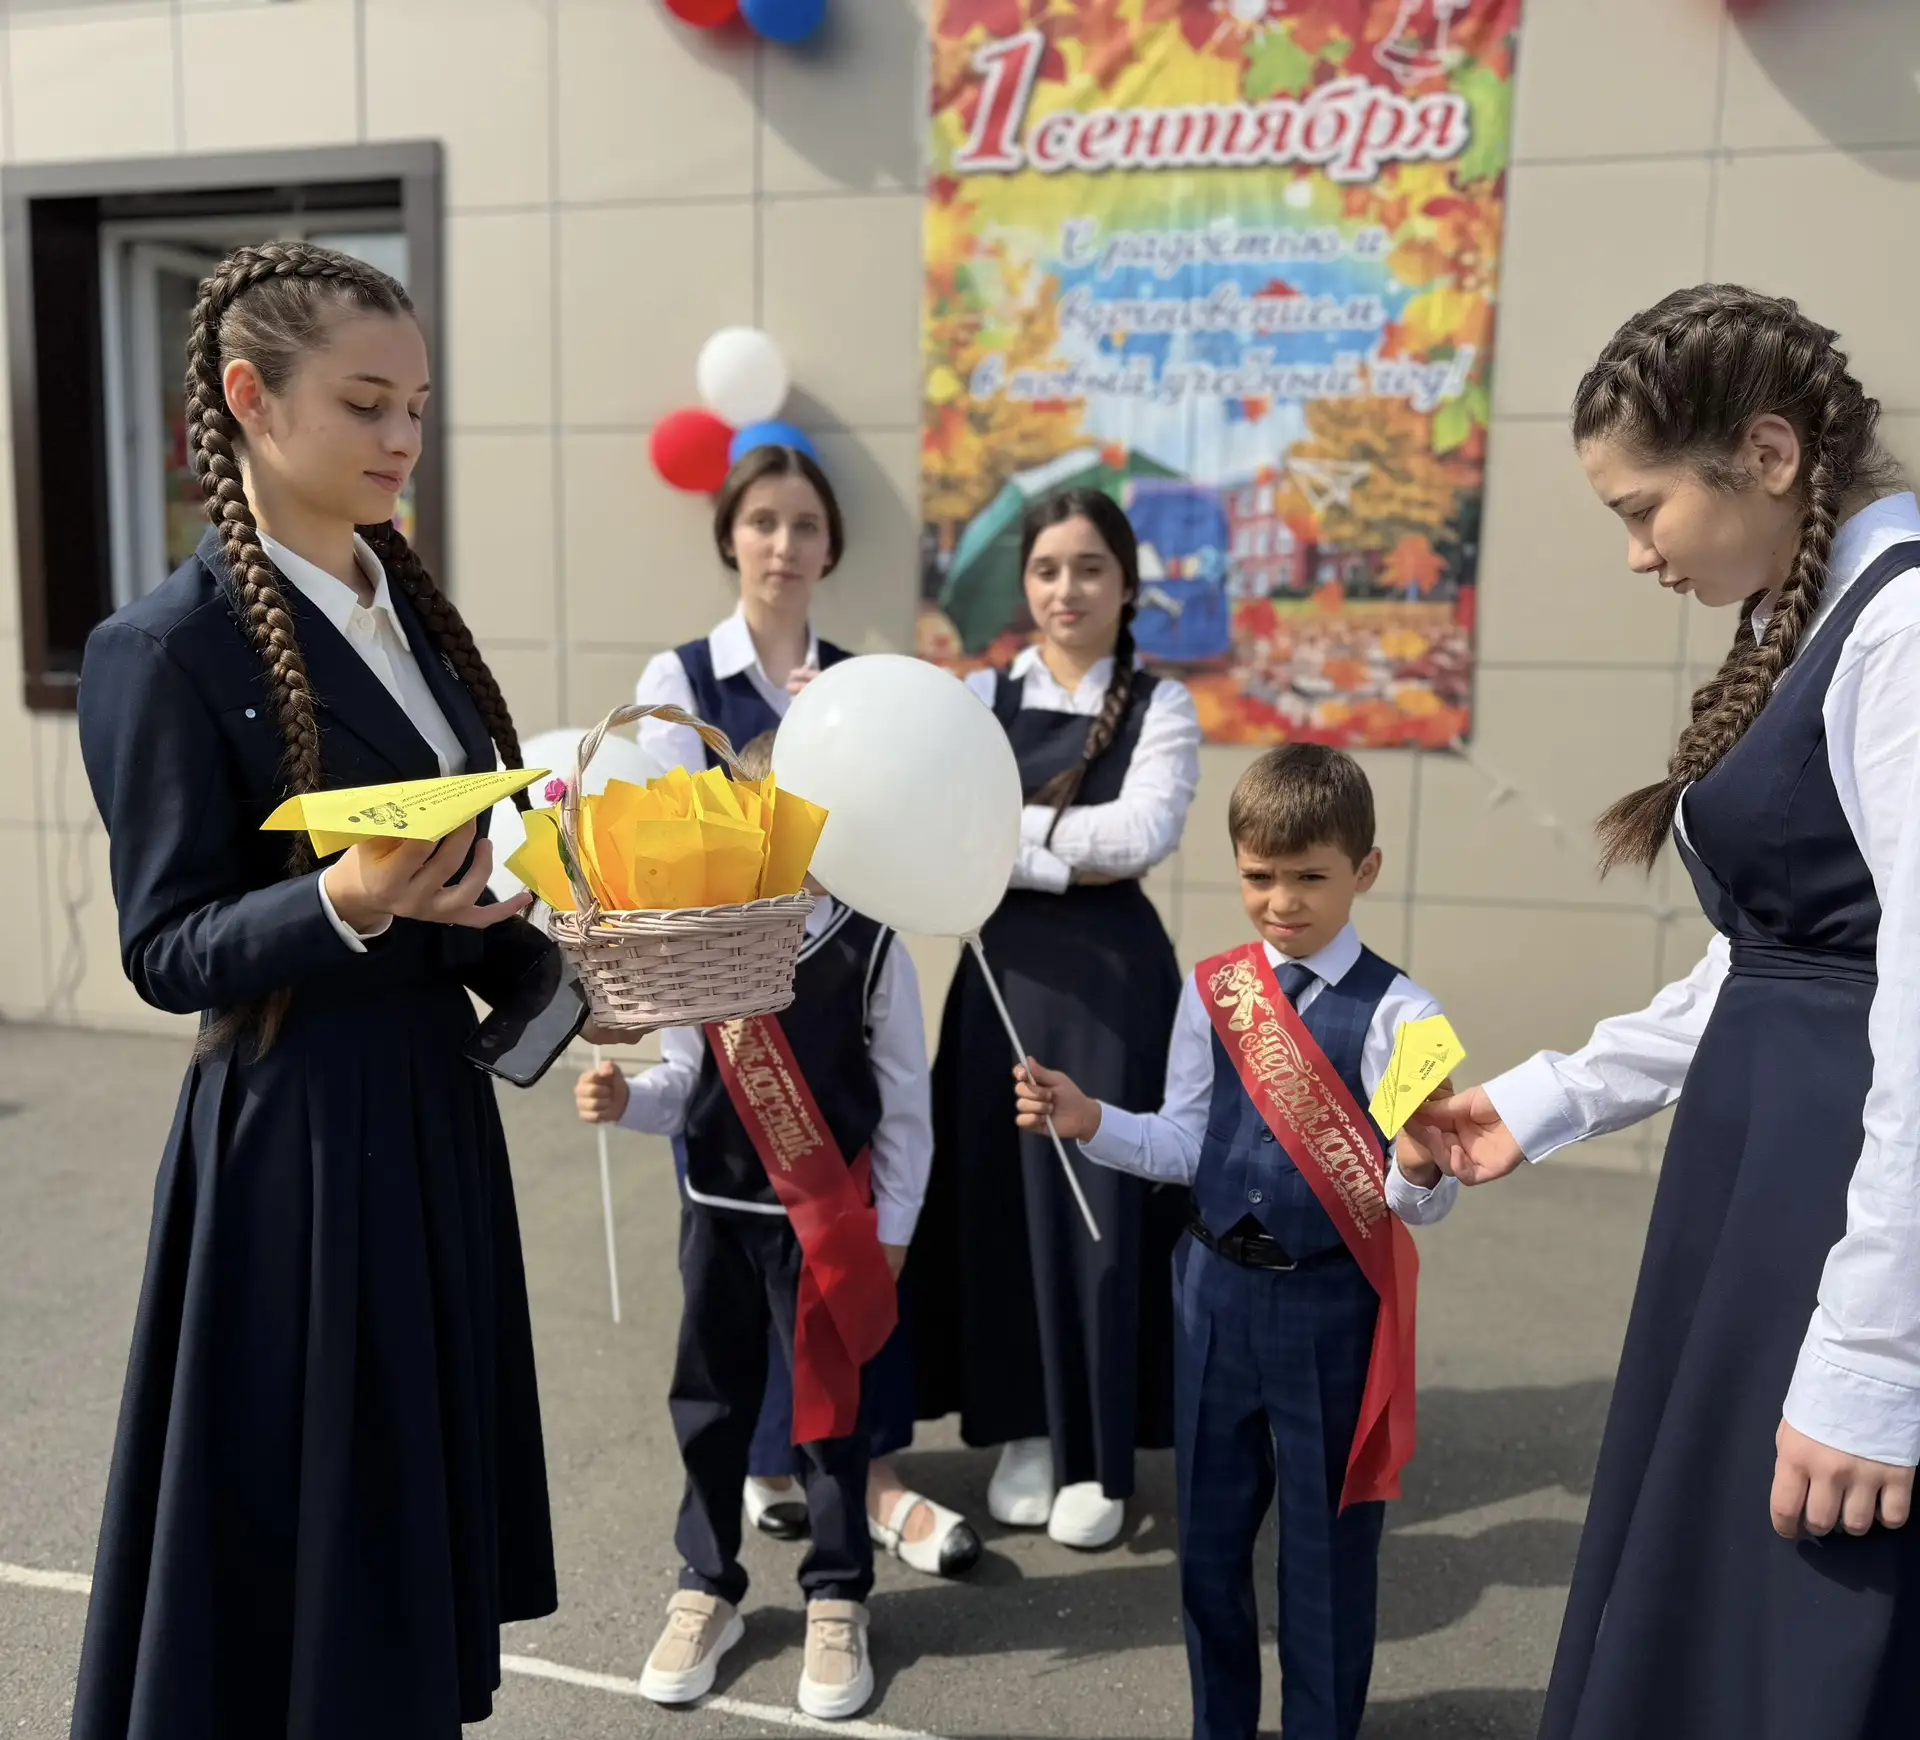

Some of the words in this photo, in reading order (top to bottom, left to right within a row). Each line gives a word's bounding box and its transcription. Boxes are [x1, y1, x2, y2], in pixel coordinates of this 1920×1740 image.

[956, 30, 1044, 173] 1
[1030, 78, 1468, 180] сентября
[725, 1018, 813, 1161] воклассник
[1238, 1021, 1388, 1226] Первоклассник
